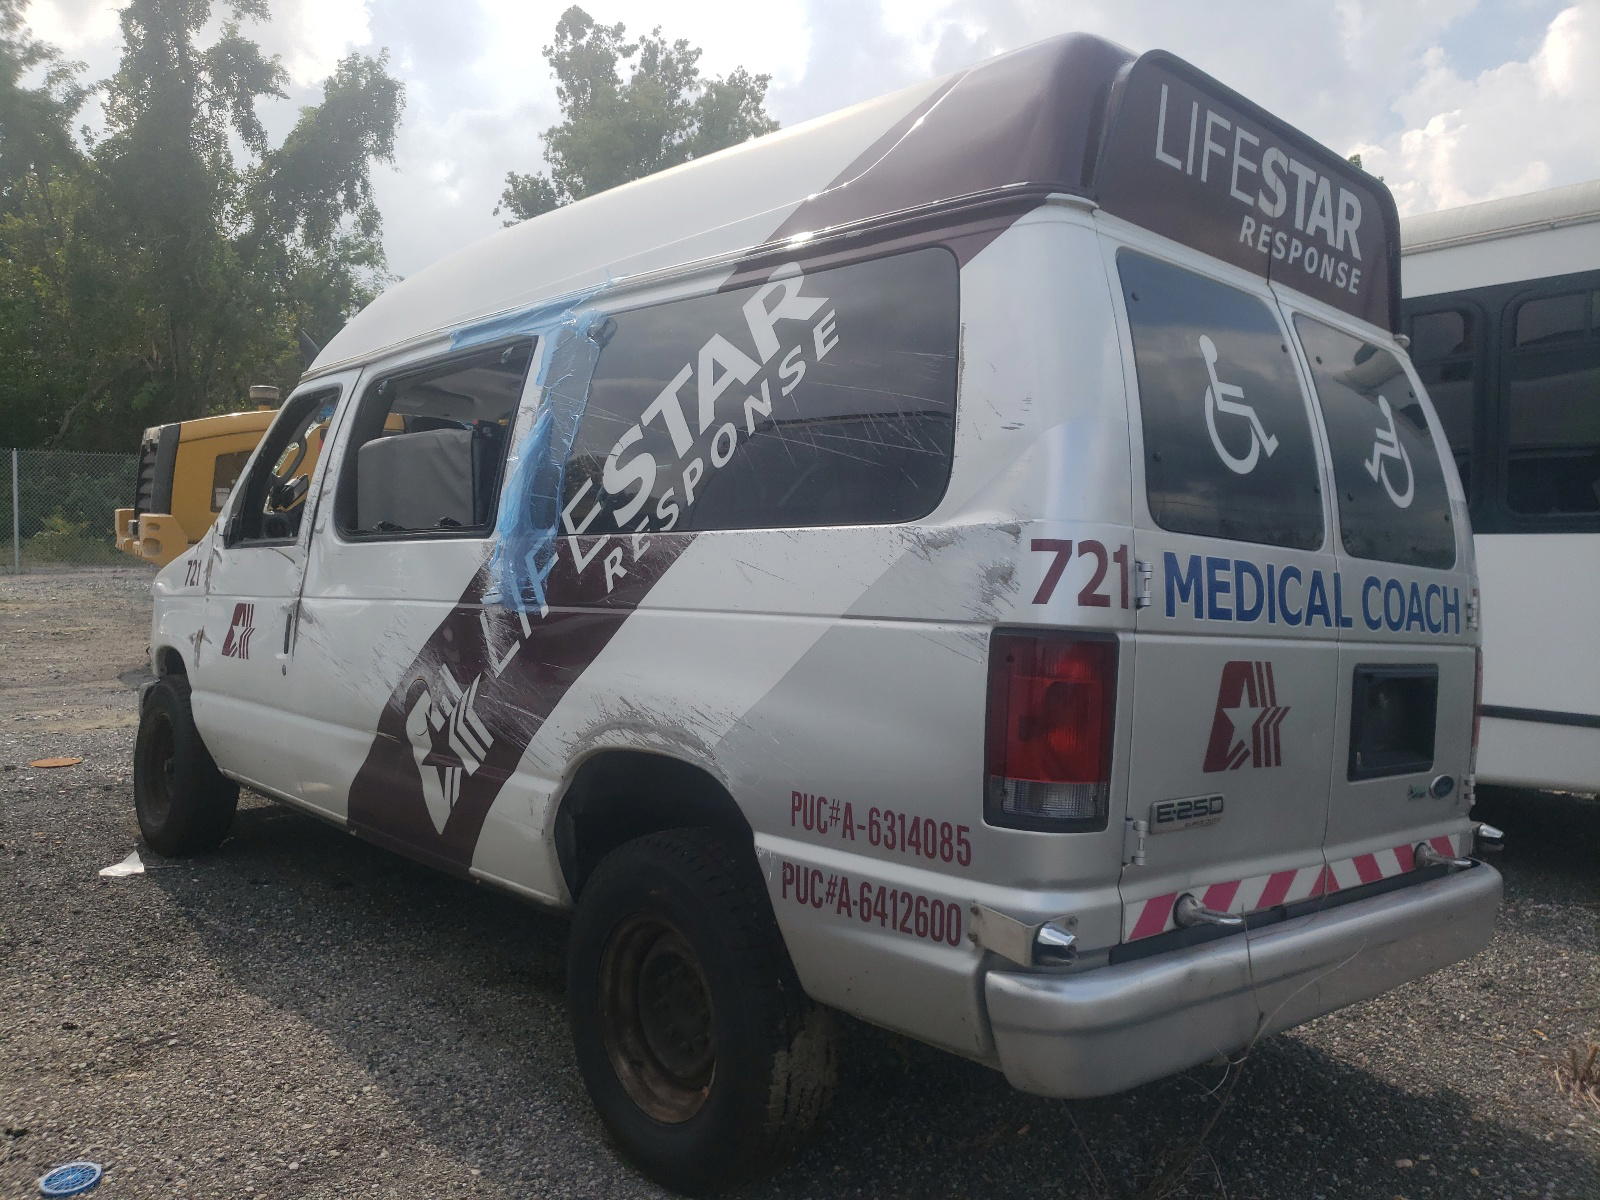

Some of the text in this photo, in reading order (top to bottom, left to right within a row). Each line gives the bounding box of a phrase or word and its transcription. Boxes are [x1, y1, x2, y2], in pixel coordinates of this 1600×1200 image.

[1155, 83, 1362, 261] LIFESTAR
[1239, 214, 1361, 295] RESPONSE
[602, 309, 840, 594] RESPONSE
[184, 559, 202, 587] 721
[1030, 538, 1129, 610] 721
[1162, 551, 1461, 635] MEDICAL COACH
[791, 790, 972, 867] PUC#A-6314085
[781, 861, 962, 947] PUC#A-6412600
